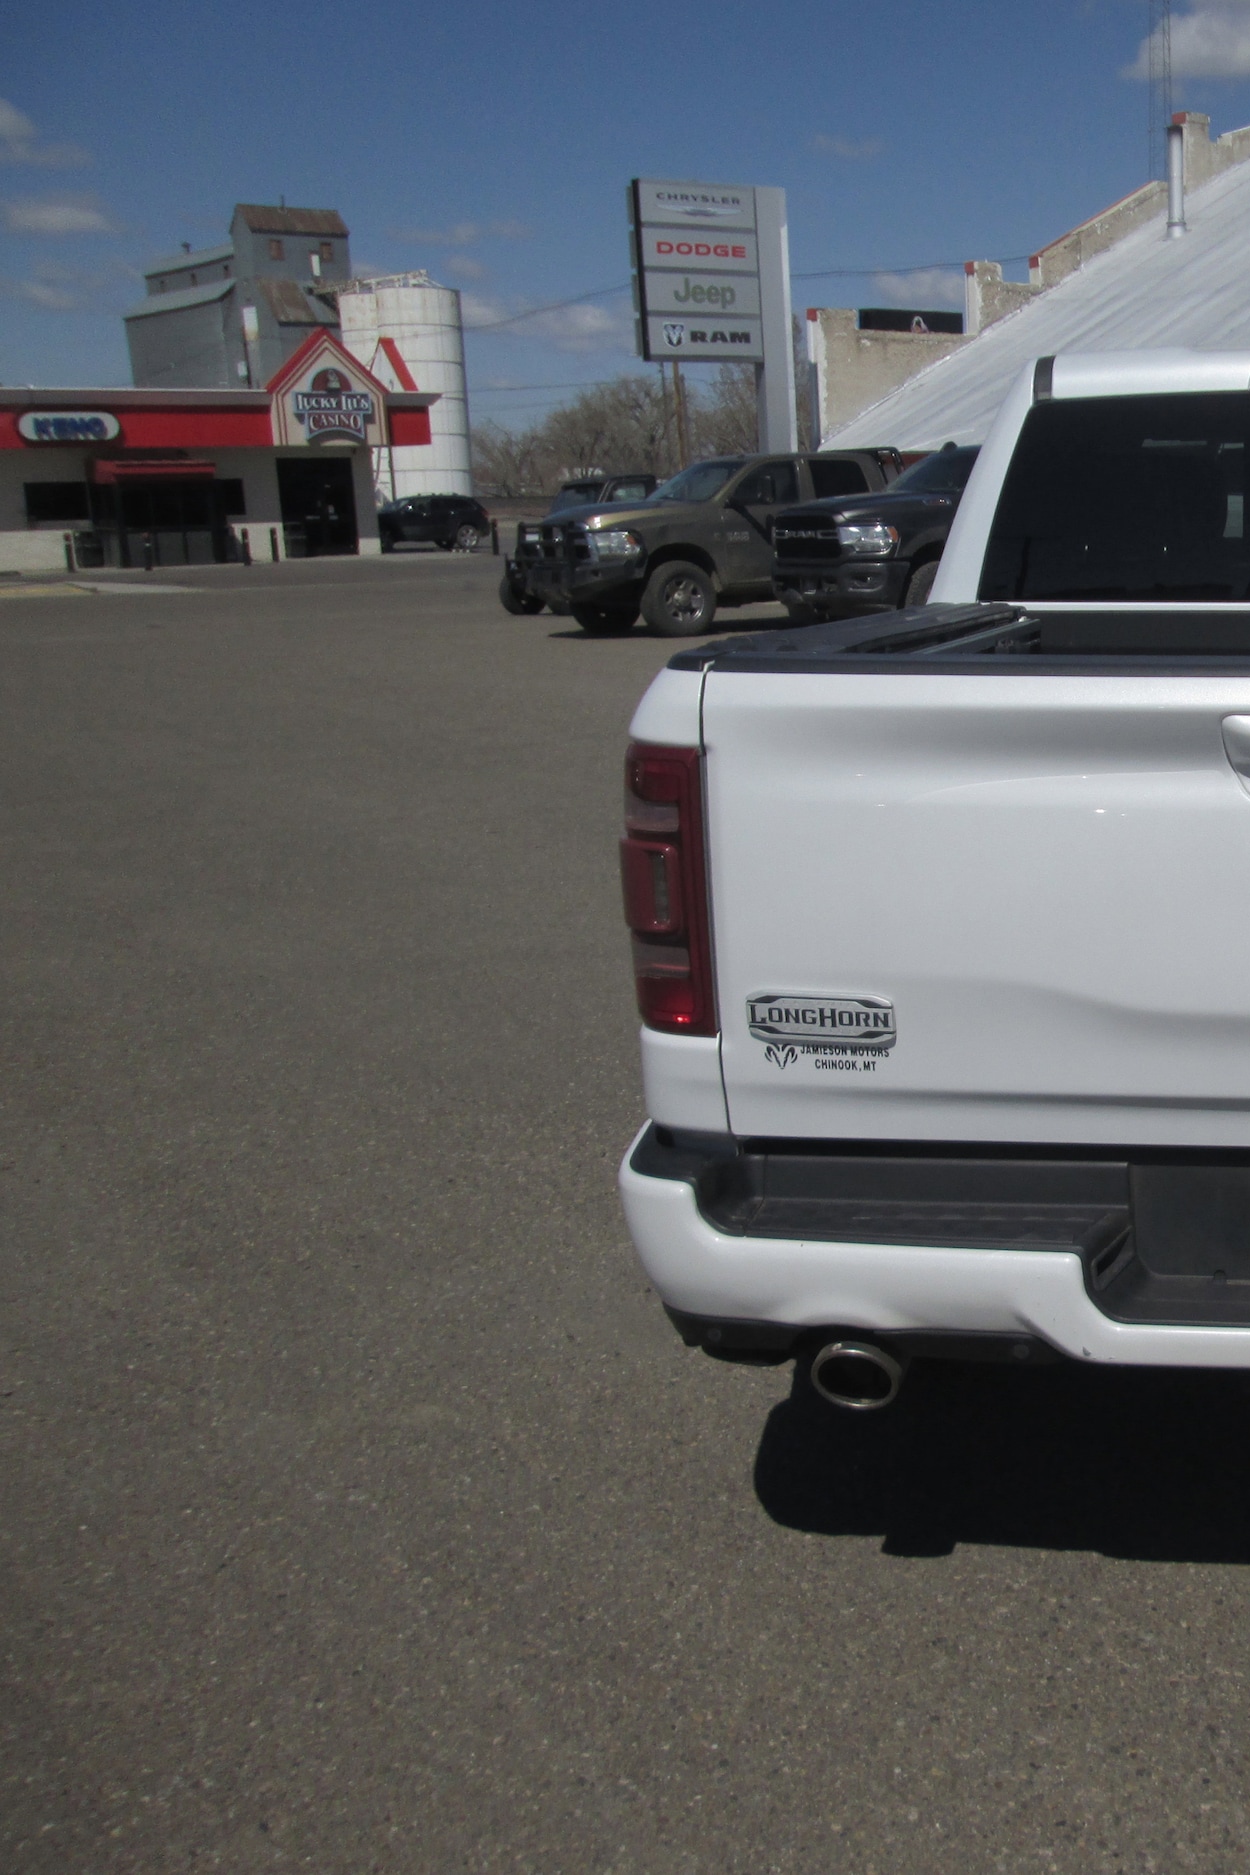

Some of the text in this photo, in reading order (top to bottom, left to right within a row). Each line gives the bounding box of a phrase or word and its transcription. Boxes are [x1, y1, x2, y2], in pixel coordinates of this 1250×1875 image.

[655, 191, 741, 206] CHRYSLER
[655, 240, 747, 259] DODGE
[673, 276, 737, 310] Jeep
[689, 329, 751, 344] RAM
[297, 394, 338, 411] LUCKY
[32, 417, 108, 439] KENO
[309, 413, 361, 431] CASINO
[749, 1003, 892, 1028] LONGHORN
[800, 1043, 890, 1058] JAMIESON MOTORS
[863, 1060, 877, 1072] MT
